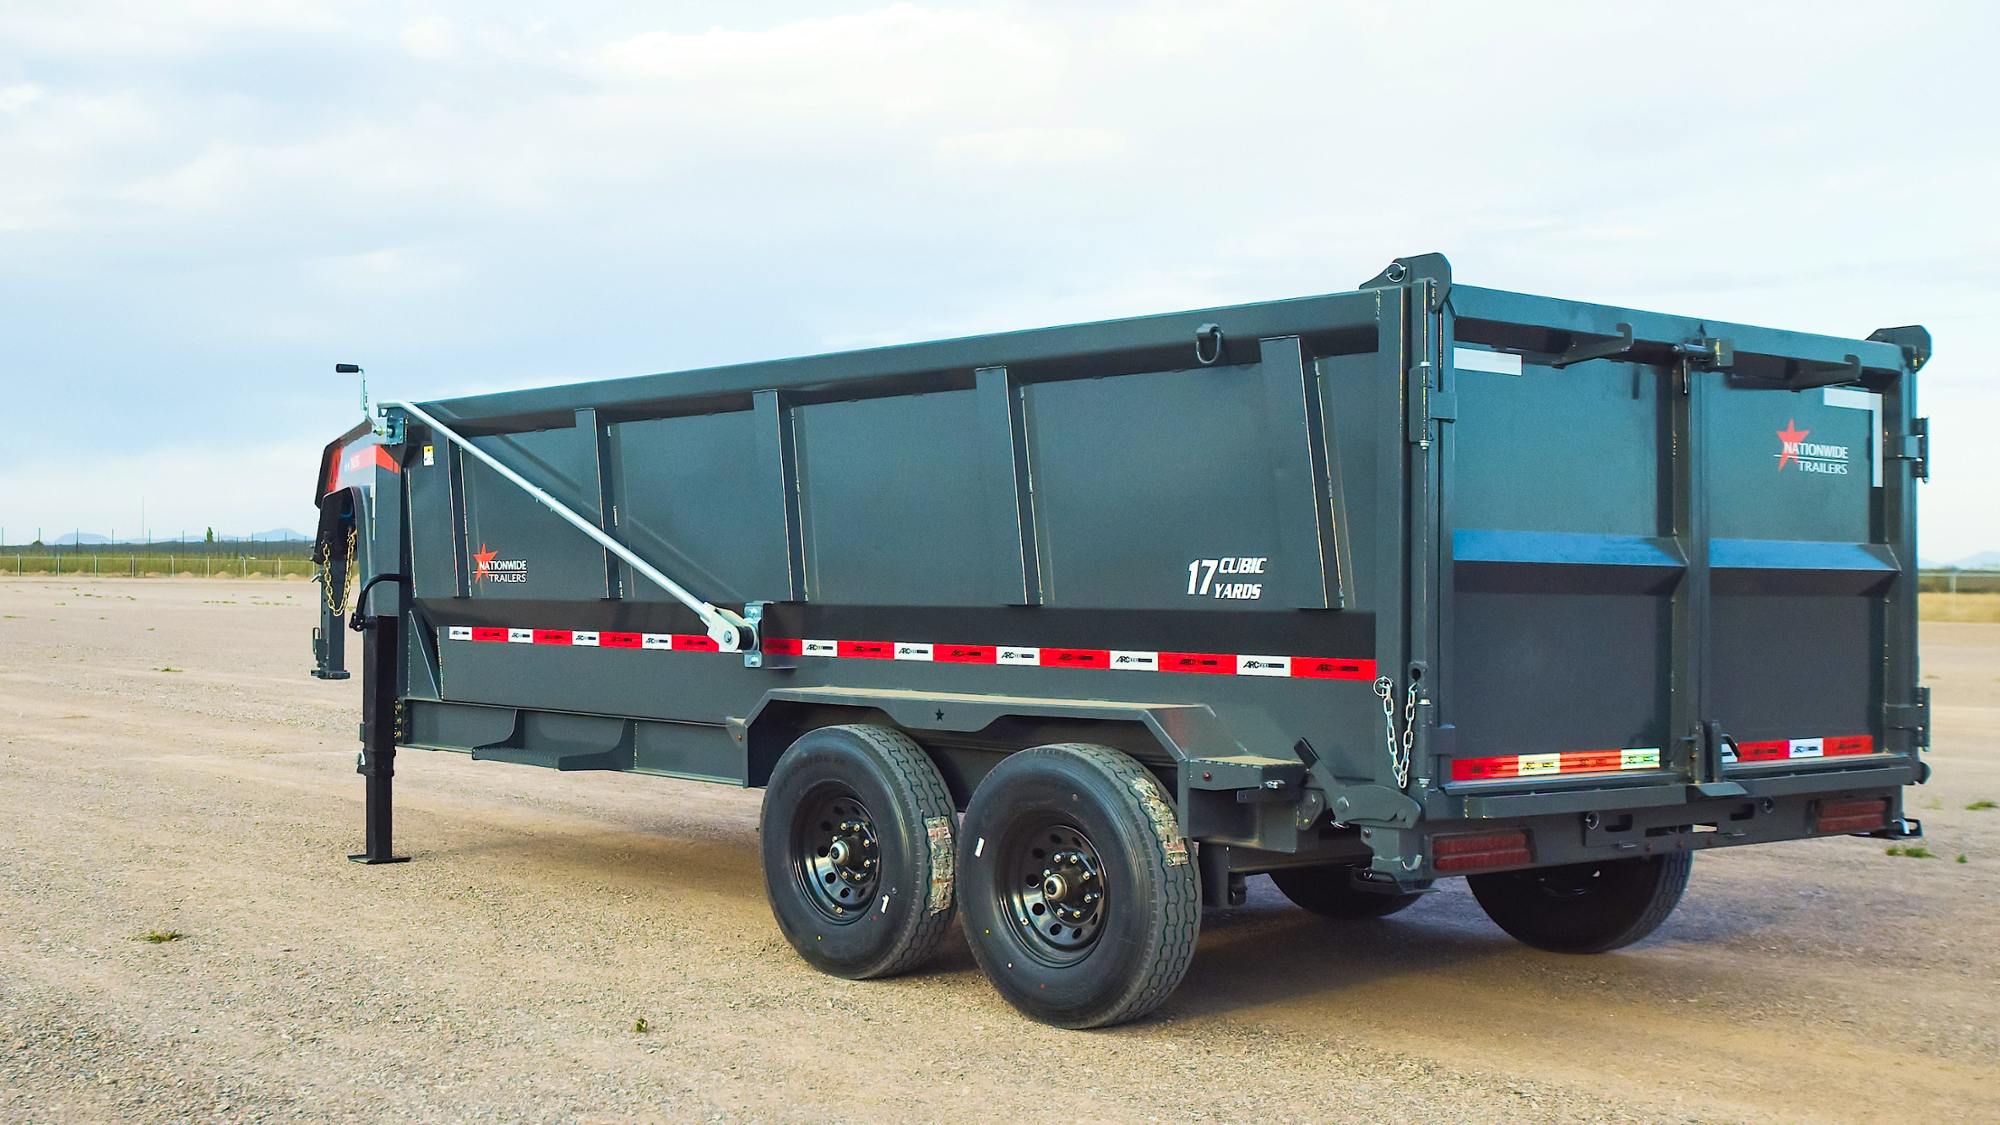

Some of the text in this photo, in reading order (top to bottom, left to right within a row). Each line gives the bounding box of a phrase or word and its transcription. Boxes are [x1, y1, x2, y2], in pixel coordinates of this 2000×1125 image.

[1783, 441, 1848, 458] NATIONWIDE
[1797, 460, 1848, 474] TRAILERS
[479, 560, 527, 570] NATIONWIDE
[1218, 557, 1267, 574] CUBIC
[489, 573, 527, 583] TRAILERS
[1187, 559, 1219, 595] 17
[1214, 583, 1262, 600] YARDS
[899, 647, 911, 655] ARC
[1001, 651, 1015, 659] ARC
[1116, 655, 1130, 663] ARC
[1243, 660, 1260, 669] ARC
